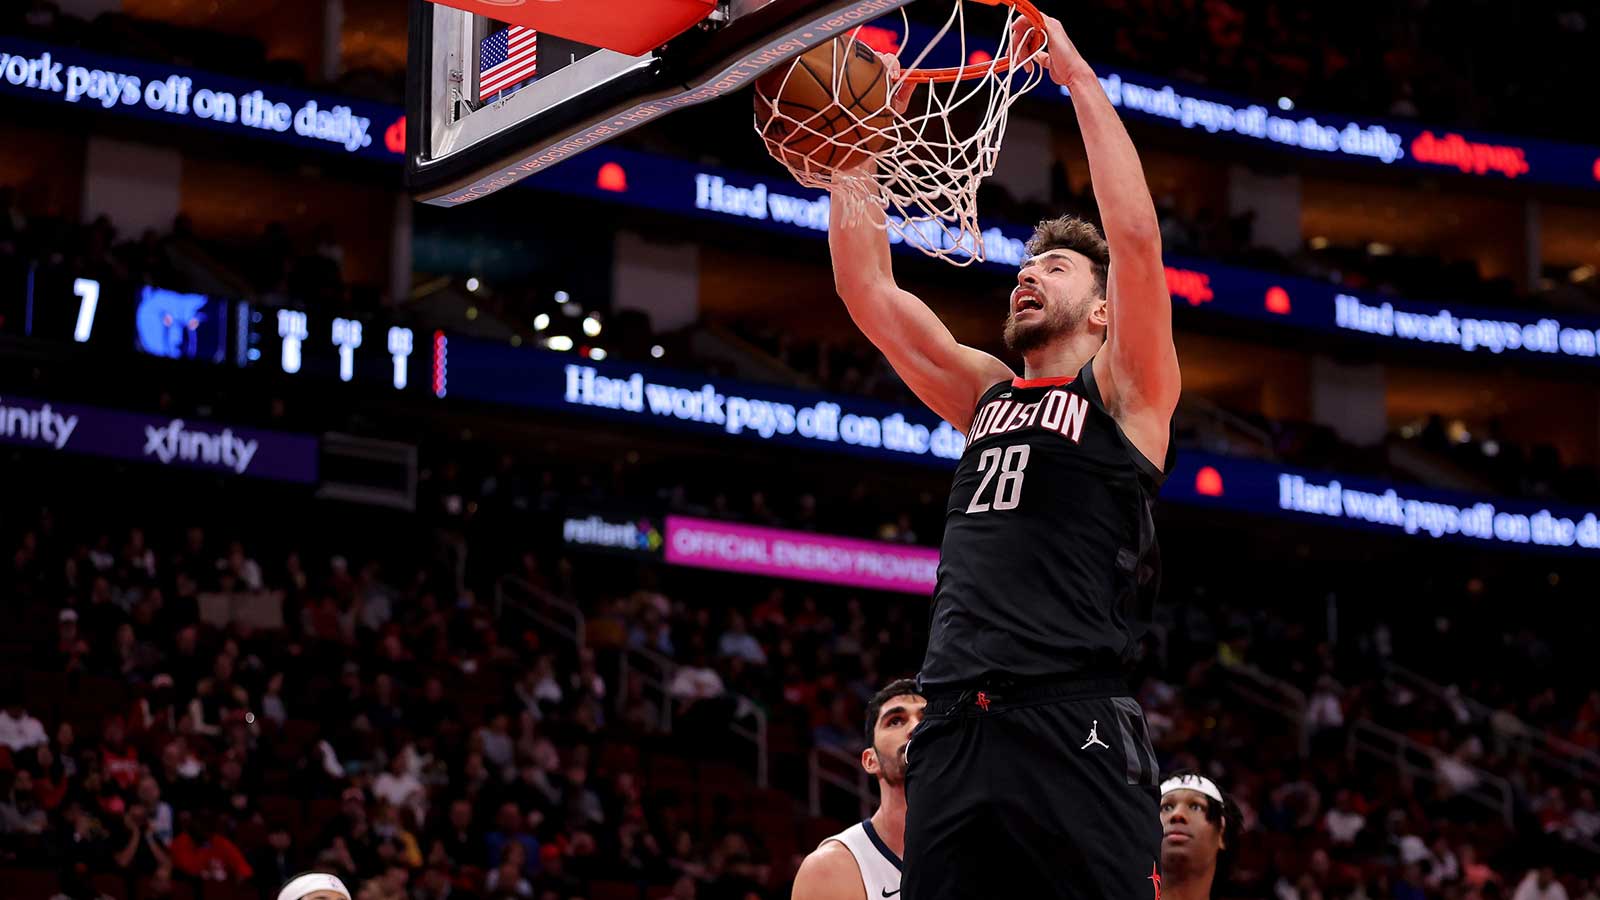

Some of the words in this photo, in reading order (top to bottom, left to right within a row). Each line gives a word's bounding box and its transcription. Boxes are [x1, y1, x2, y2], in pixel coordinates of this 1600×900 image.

[65, 65, 142, 108] pays
[144, 74, 192, 114] off
[193, 88, 238, 123] on
[240, 90, 292, 132] the
[623, 103, 662, 122] Hair
[660, 68, 751, 108] Transplant
[745, 36, 808, 67] Turkey
[694, 173, 769, 220] Hard
[73, 278, 100, 343] 7
[1335, 294, 1395, 336] Hard
[1394, 309, 1462, 345] work
[1460, 318, 1523, 353] pays
[564, 364, 644, 412] Hard
[645, 384, 726, 424] work
[725, 395, 797, 439] pays
[796, 401, 840, 441] off
[839, 413, 882, 448] on
[881, 413, 930, 454] the
[967, 389, 1087, 447] HOUSTON
[144, 418, 259, 475] xfinity
[966, 444, 1030, 514] 28
[1278, 473, 1343, 516] Hard
[1342, 488, 1404, 526] work
[1403, 499, 1460, 538] pays
[564, 516, 638, 550] reliant
[673, 528, 770, 564] OFFICIAL
[772, 538, 853, 573] ENERGY
